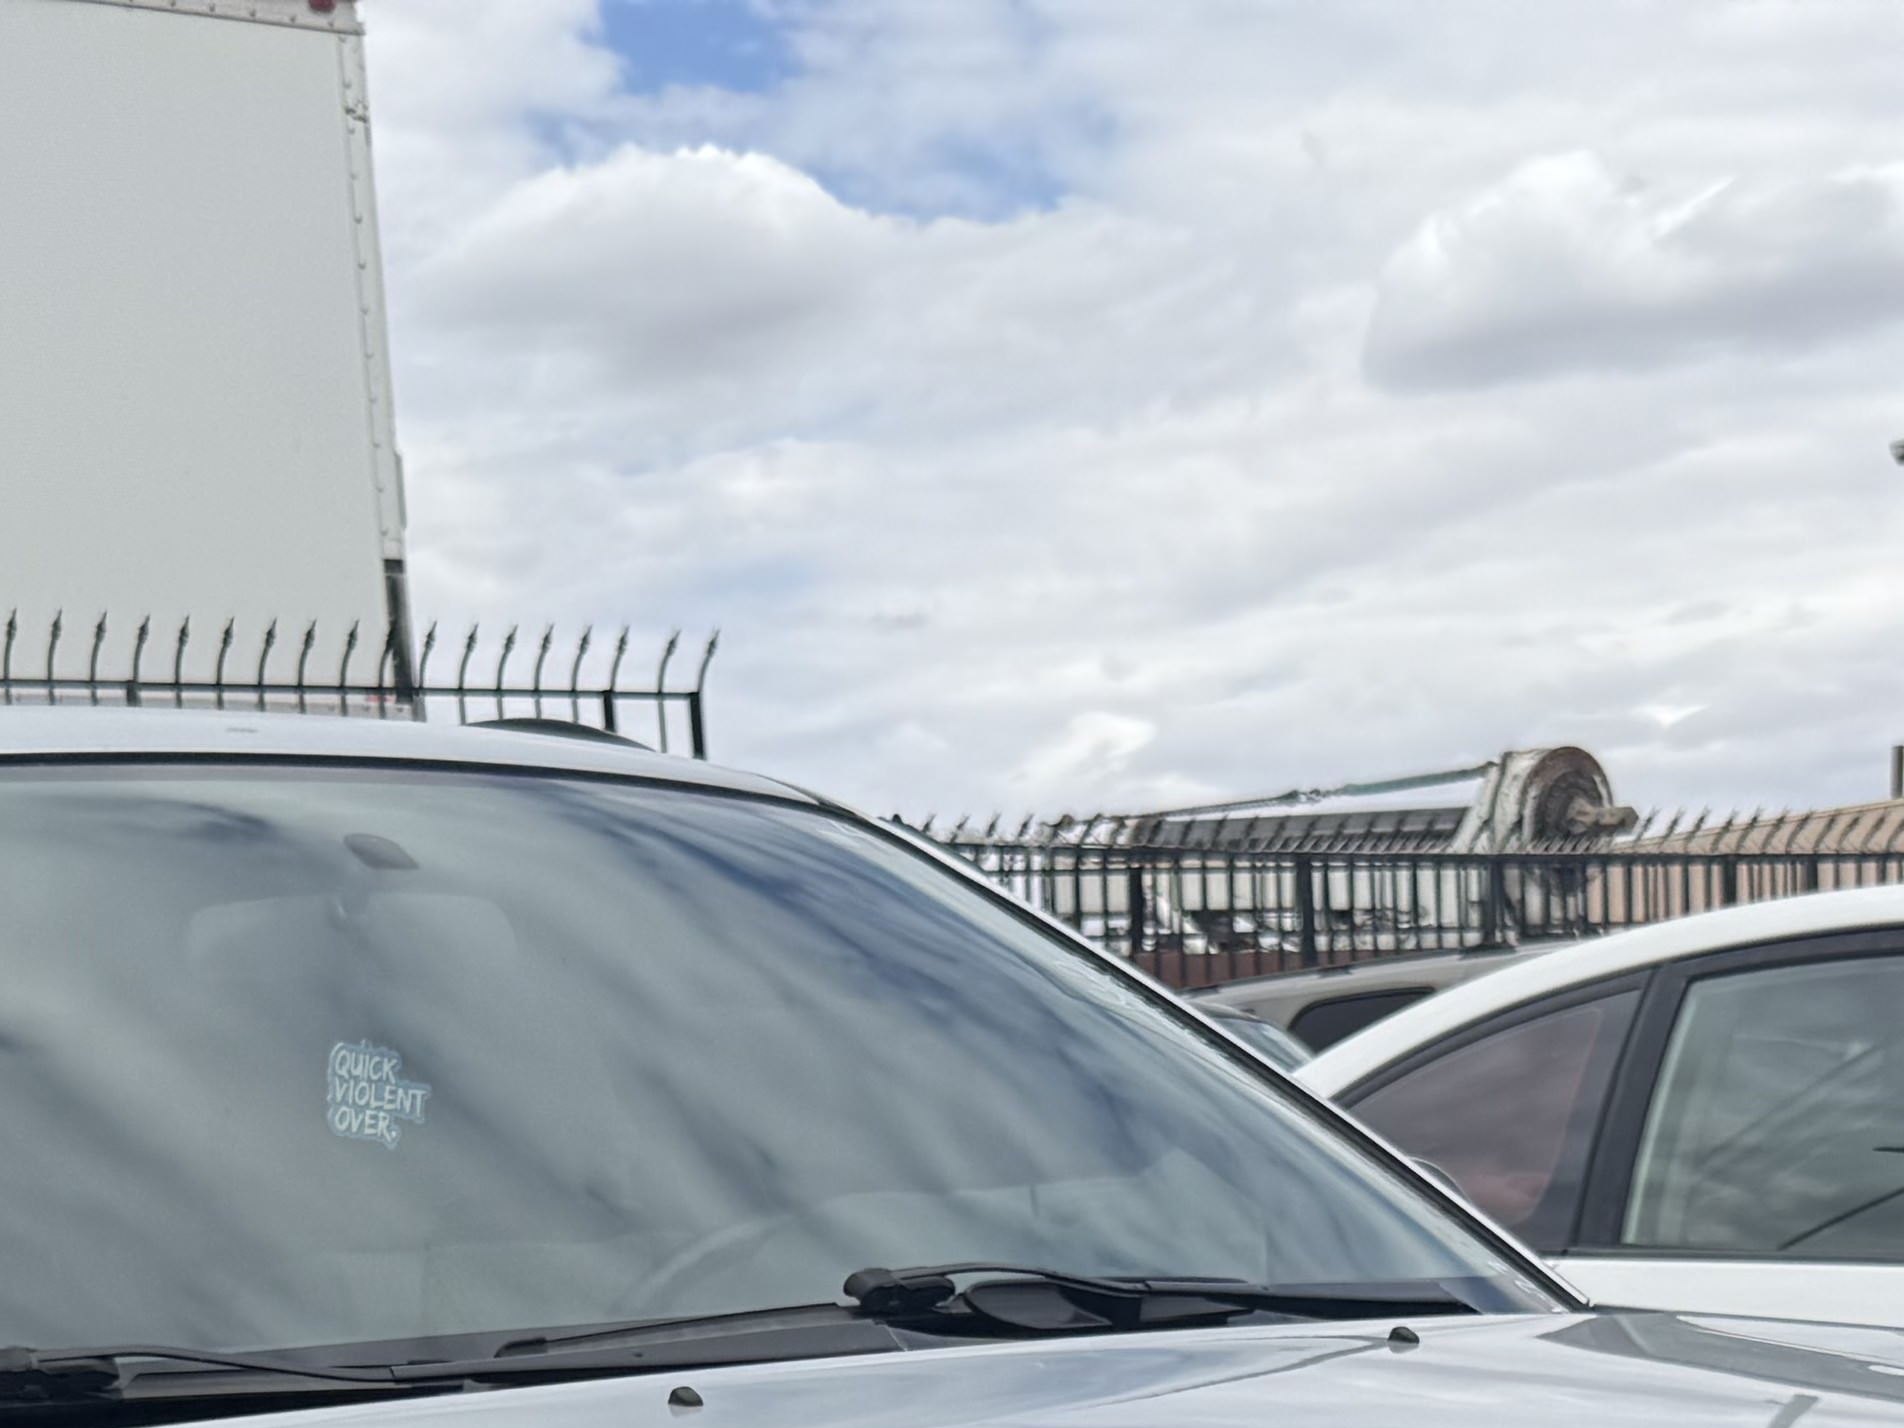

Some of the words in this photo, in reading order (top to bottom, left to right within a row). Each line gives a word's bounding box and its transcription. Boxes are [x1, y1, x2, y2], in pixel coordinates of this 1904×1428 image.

[335, 1048, 398, 1085] QUICK
[334, 1075, 429, 1118] VIOLENT
[335, 1105, 397, 1142] OVER.
